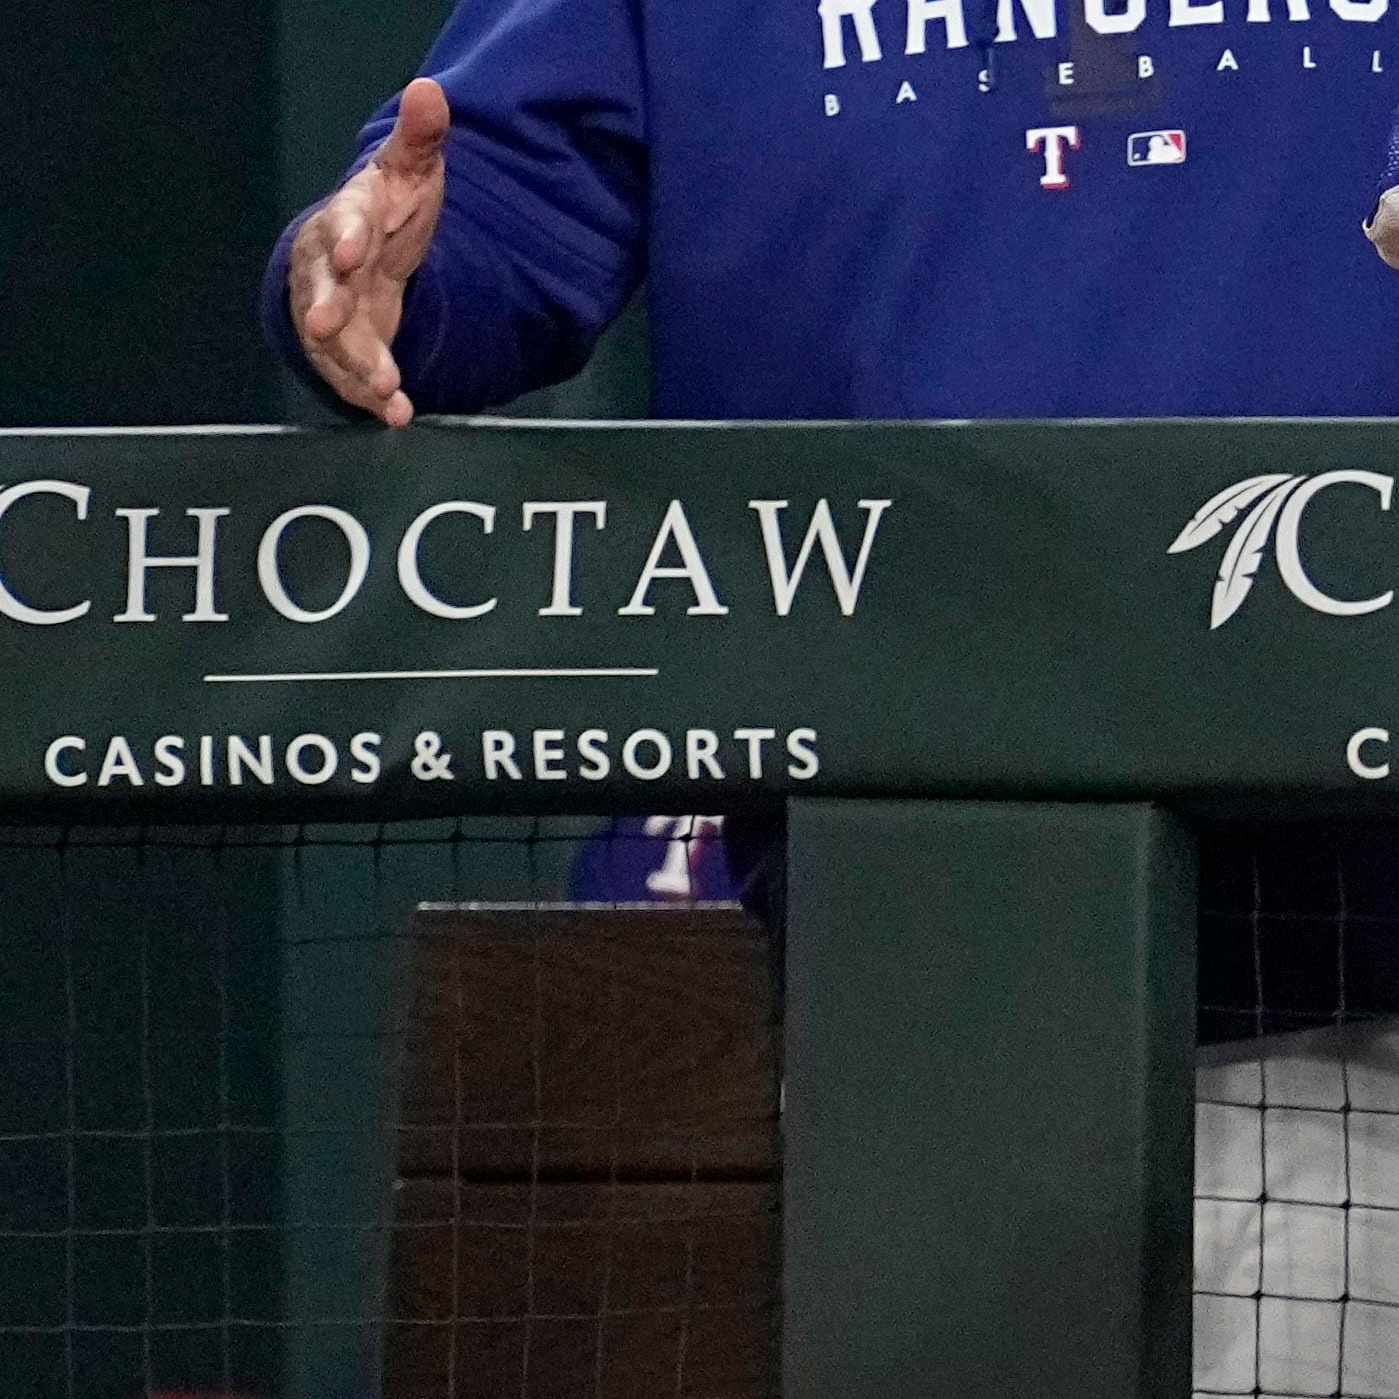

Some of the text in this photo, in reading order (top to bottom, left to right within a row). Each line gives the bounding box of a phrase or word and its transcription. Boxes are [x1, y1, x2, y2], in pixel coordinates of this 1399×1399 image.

[822, 45, 1385, 118] BASEBALL
[1026, 125, 1080, 189] T
[0, 479, 893, 625] CHOCTAW
[44, 727, 820, 787] CASINOS & RESORTS
